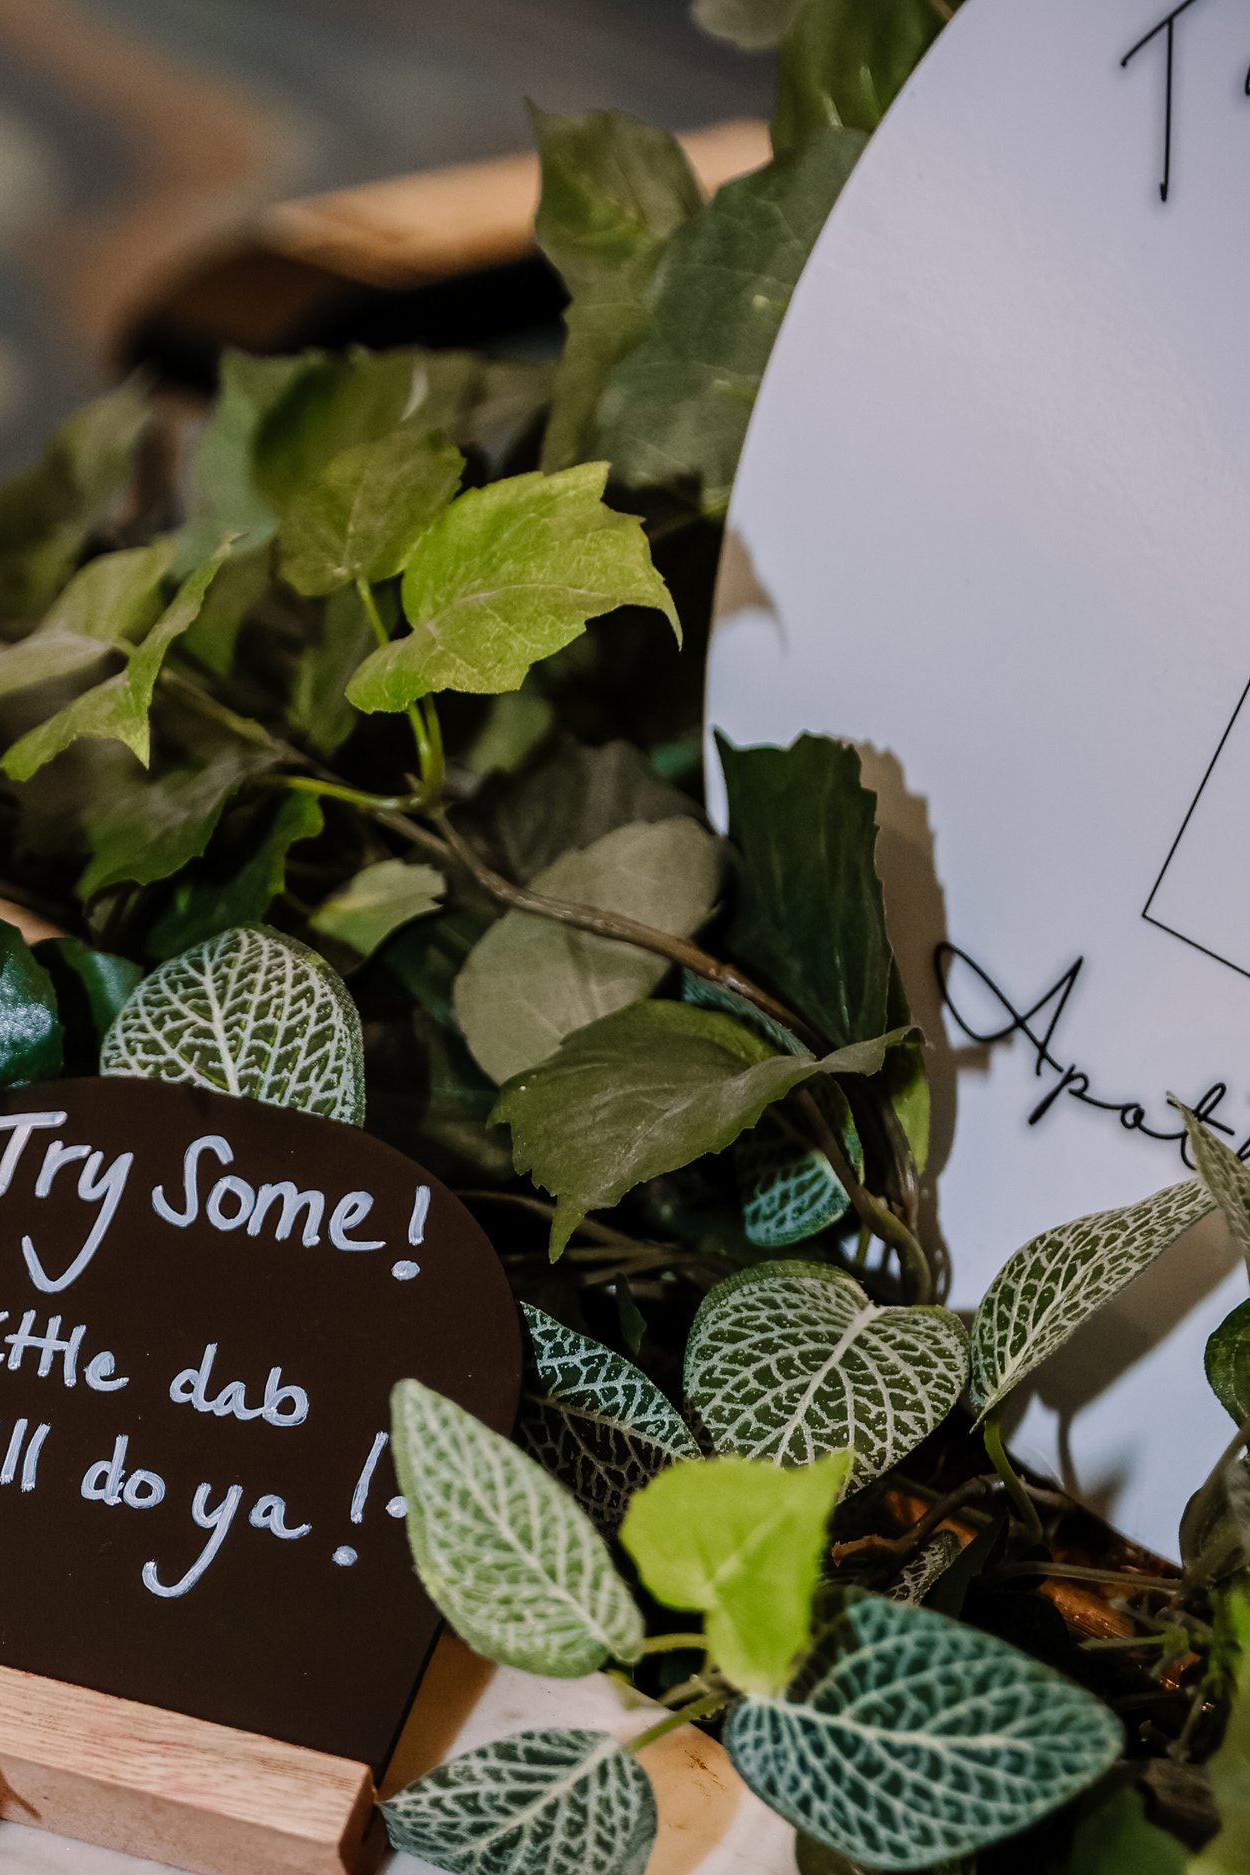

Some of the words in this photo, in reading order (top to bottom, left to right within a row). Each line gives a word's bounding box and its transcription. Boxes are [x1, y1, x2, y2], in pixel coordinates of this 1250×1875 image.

[1120, 0, 1250, 202] T
[934, 941, 1250, 1170] Apot
[152, 1135, 431, 1281] Some!
[169, 1343, 309, 1427] dab
[81, 1434, 166, 1509] do
